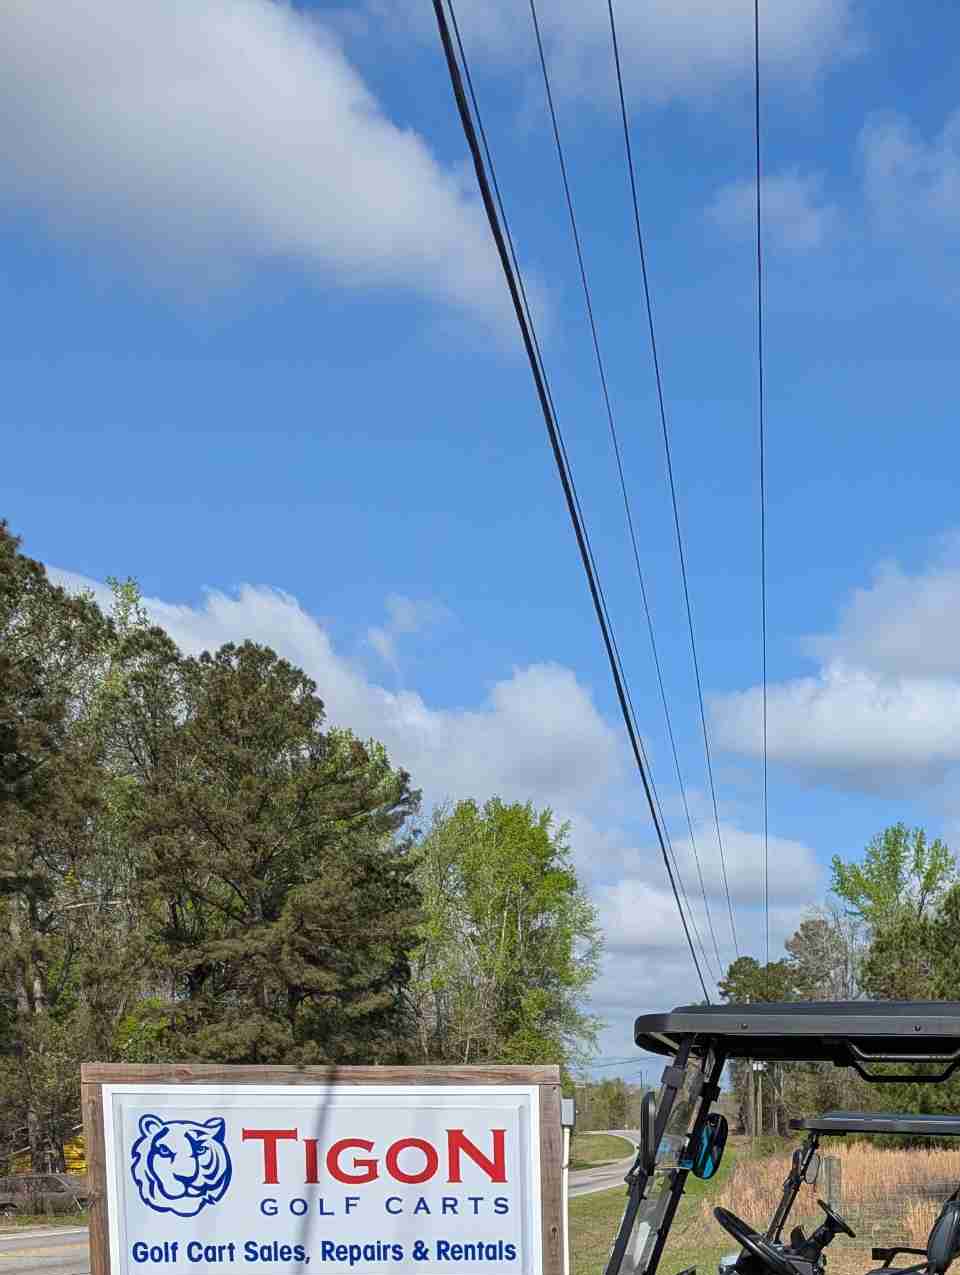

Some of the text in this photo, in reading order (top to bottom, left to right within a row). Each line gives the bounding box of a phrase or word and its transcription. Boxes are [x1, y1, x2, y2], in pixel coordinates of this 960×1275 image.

[242, 1128, 508, 1185] TIGON
[260, 1196, 510, 1217] GOLF CARTS
[131, 1239, 517, 1265] Golf Cart Sales, Repairs & Rentals
